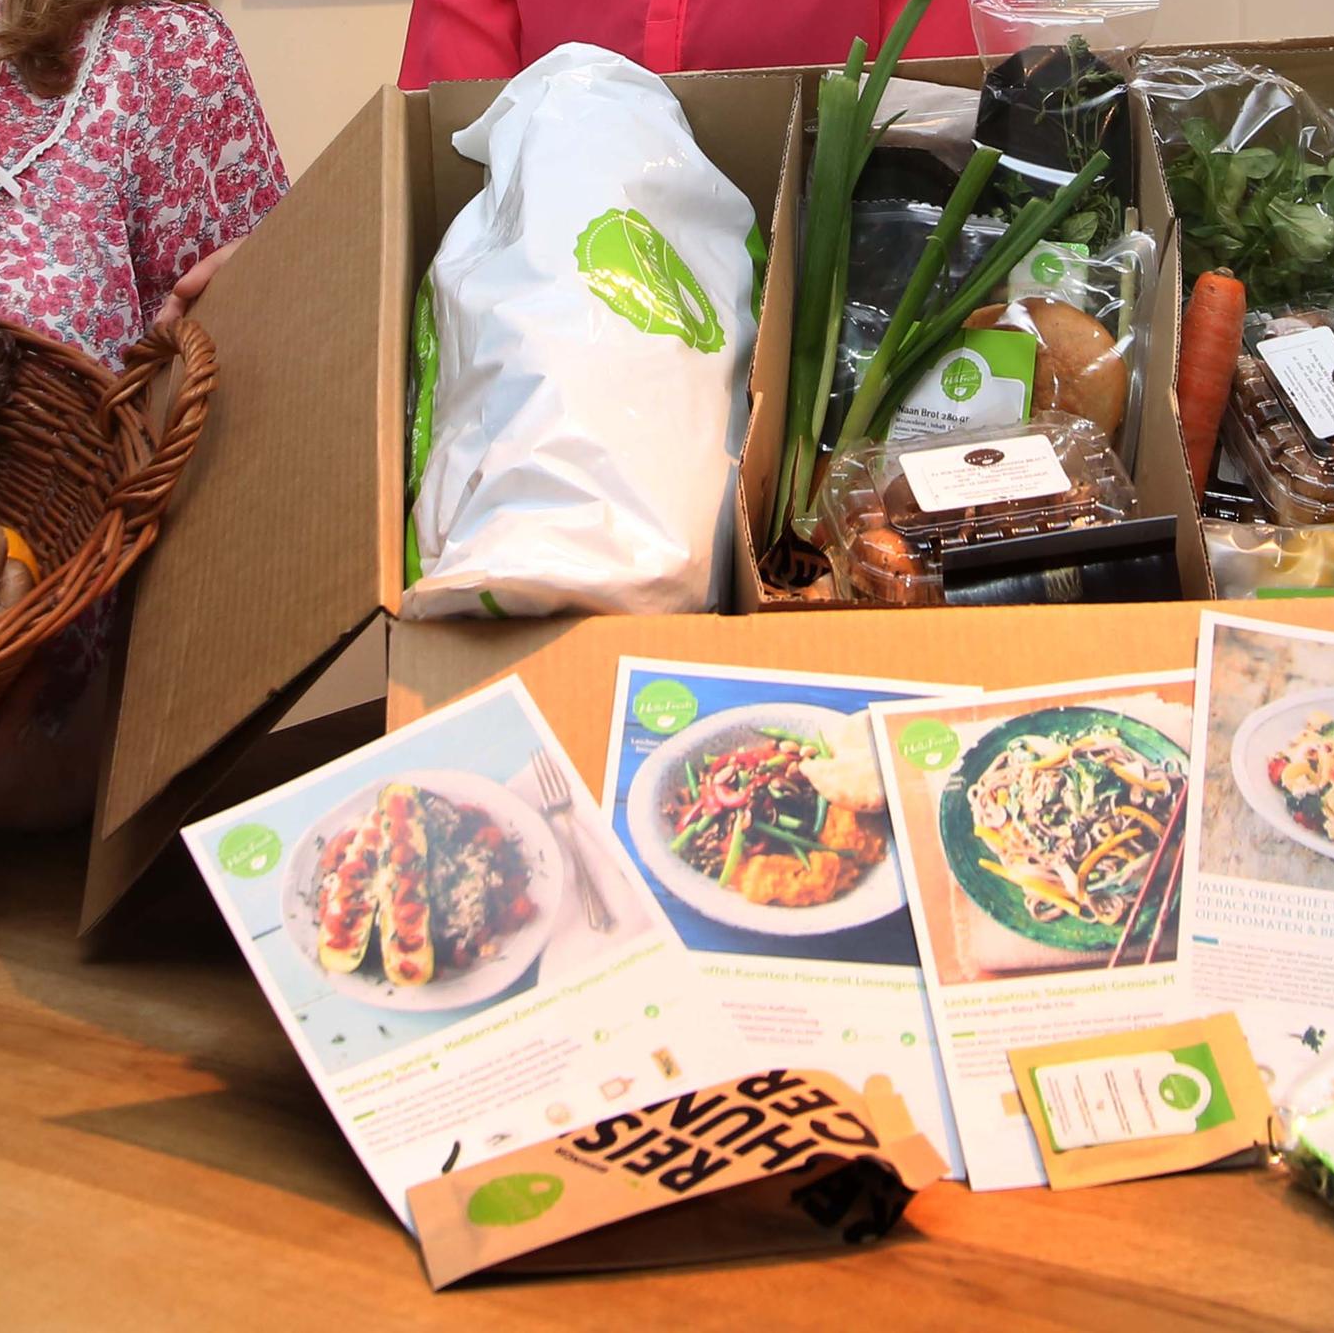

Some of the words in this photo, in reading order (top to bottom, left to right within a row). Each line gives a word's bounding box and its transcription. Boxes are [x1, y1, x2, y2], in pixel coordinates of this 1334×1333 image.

[898, 404, 920, 416] Naan
[921, 408, 940, 420] Brot
[941, 412, 958, 423] 280
[903, 733, 955, 757] HelloFresh
[1196, 880, 1245, 899] JAMIES
[1195, 896, 1293, 920] GEBACKENEM
[1194, 909, 1304, 936] OFENTOMATEN
